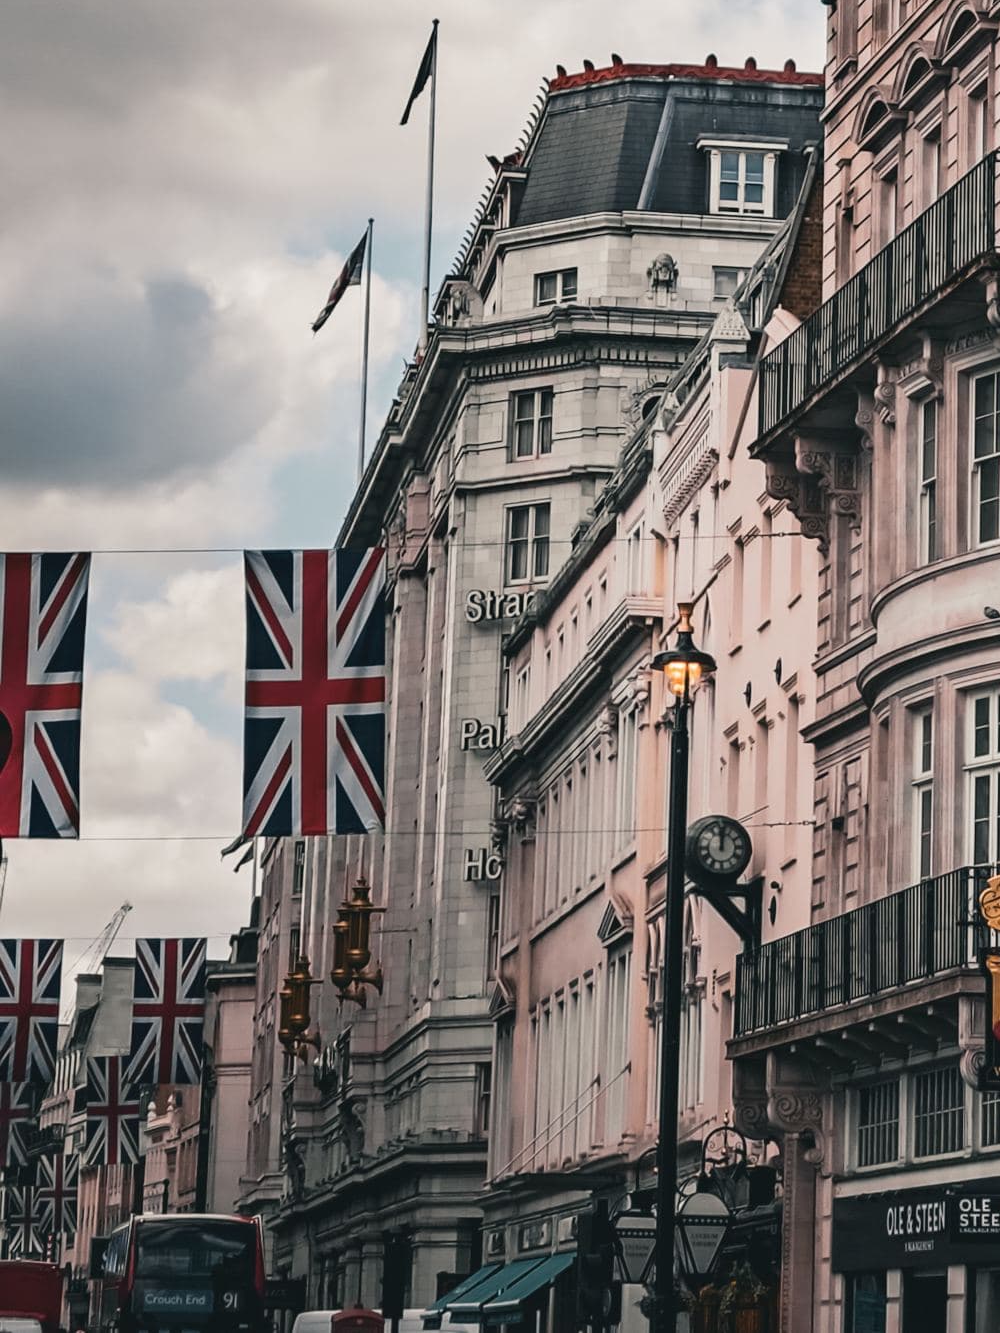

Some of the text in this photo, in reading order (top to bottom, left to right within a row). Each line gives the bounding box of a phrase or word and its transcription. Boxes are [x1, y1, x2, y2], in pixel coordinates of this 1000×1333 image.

[958, 1198, 991, 1213] OLE
[886, 1201, 946, 1236] OLE & STEEN
[144, 1292, 238, 1309] Crouch End 91
